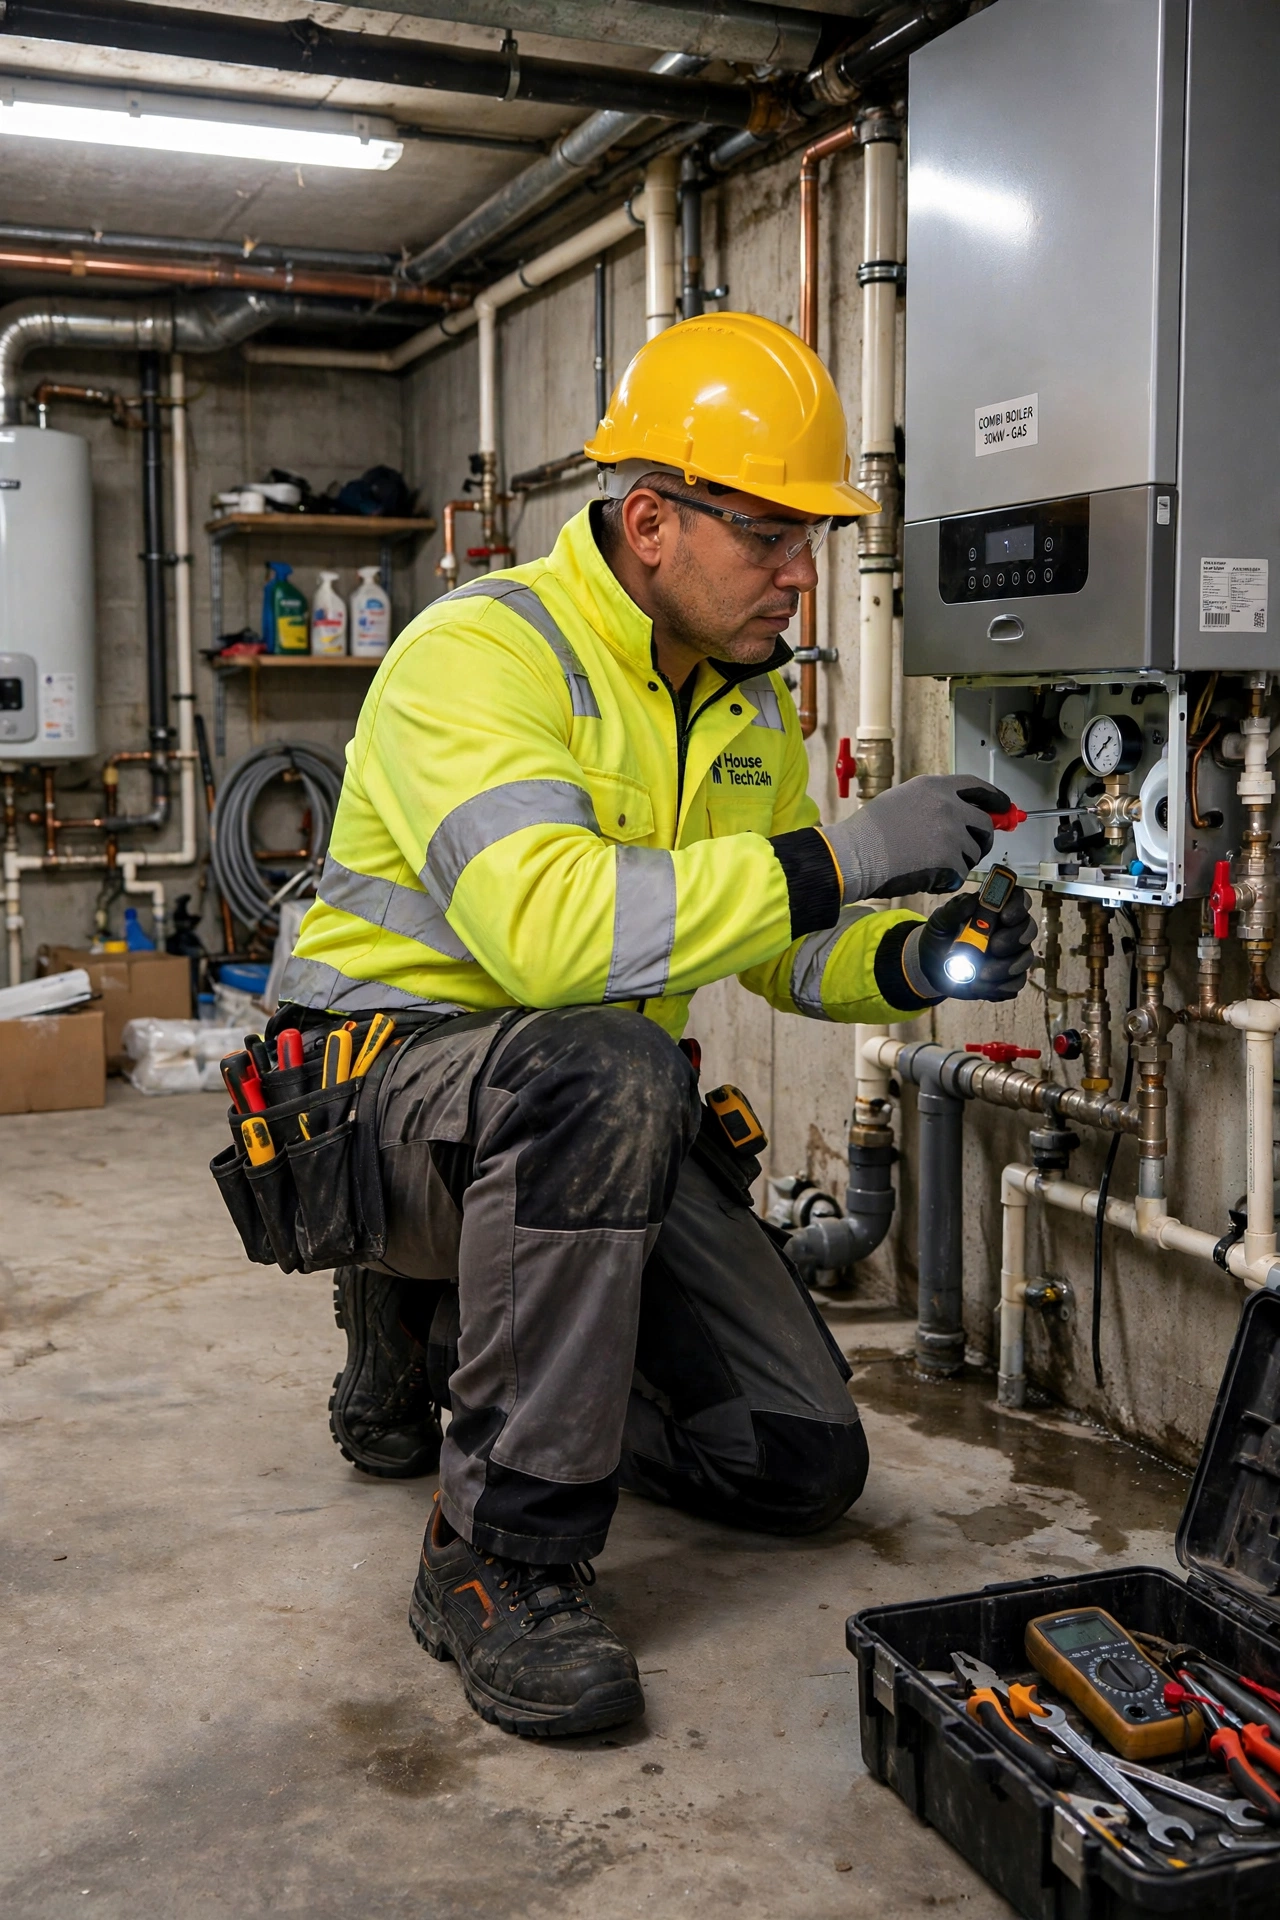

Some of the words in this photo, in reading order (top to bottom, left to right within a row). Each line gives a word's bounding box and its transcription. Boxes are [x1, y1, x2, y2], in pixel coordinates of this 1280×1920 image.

[978, 413, 1003, 430] COMBI
[1005, 406, 1034, 423] BOILER
[983, 429, 1006, 445] 30kW
[1011, 424, 1028, 439] GAS
[723, 752, 763, 768] House
